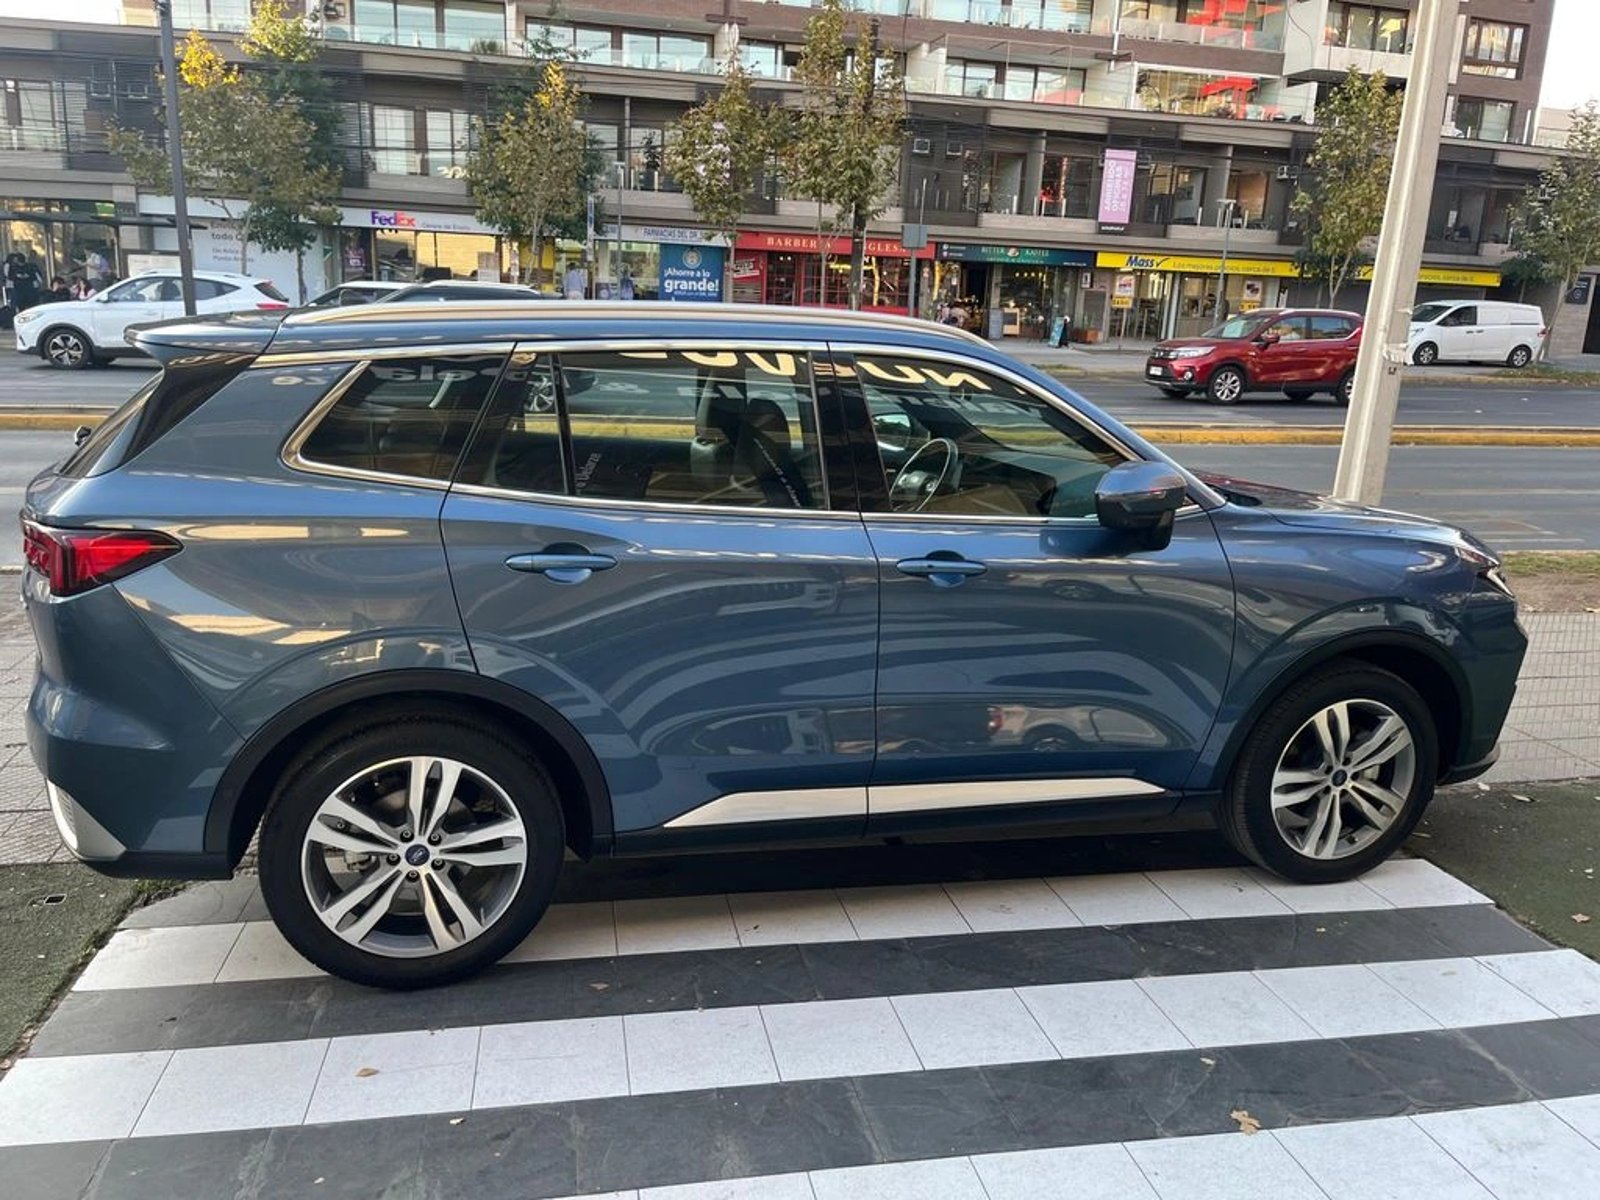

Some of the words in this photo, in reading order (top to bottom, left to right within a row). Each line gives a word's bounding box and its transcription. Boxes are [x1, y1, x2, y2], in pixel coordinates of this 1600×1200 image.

[371, 210, 416, 228] FedEx
[643, 228, 675, 237] FARMACIAS
[767, 237, 831, 249] BARBERA
[1126, 255, 1155, 268] Mass
[702, 268, 710, 277] lo
[663, 278, 720, 293] grande!
